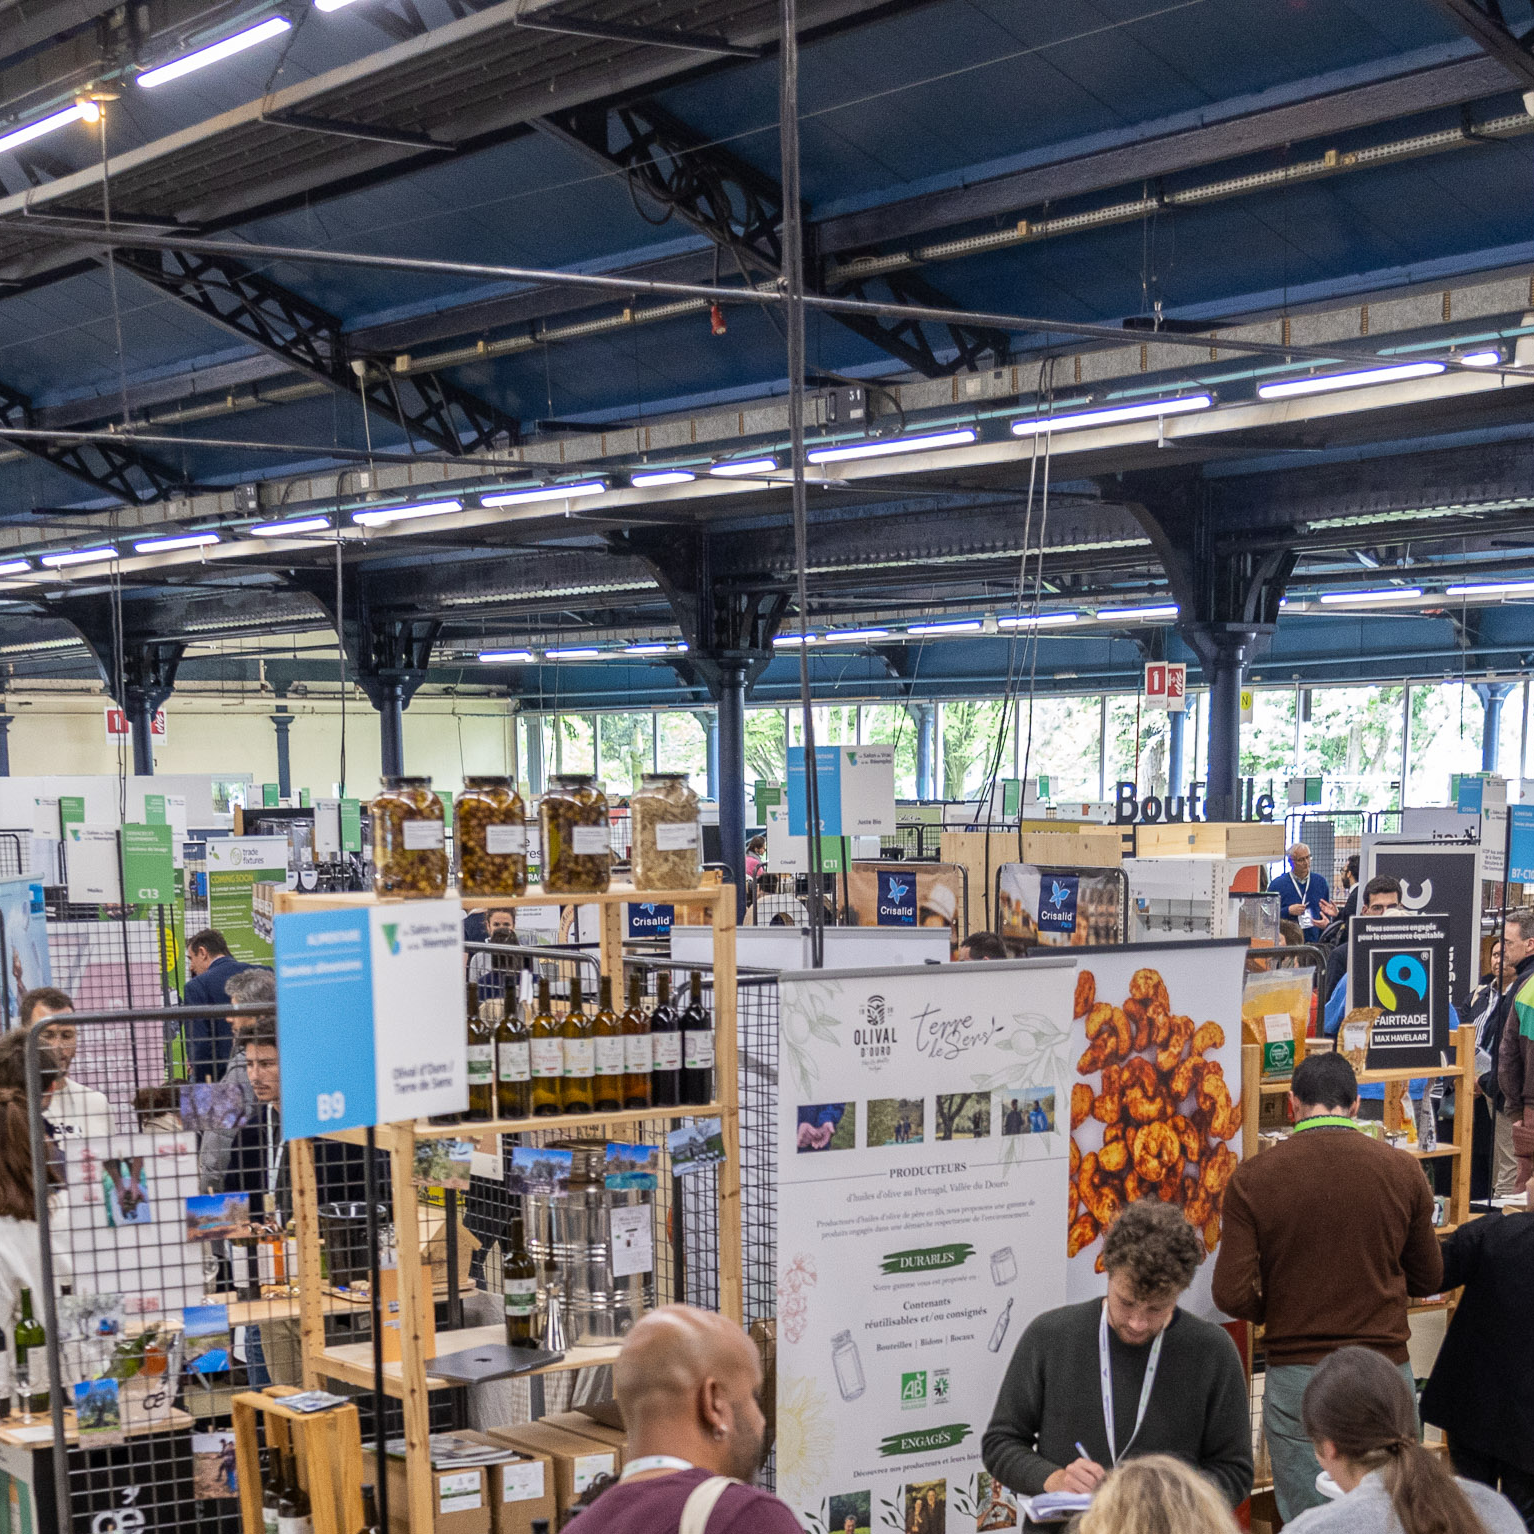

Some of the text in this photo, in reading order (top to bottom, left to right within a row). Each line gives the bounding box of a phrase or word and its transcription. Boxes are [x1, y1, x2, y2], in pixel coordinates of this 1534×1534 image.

[1116, 779, 1274, 823] Boutlle
[243, 848, 258, 856] trade
[242, 855, 265, 865] fixtures
[824, 859, 838, 869] C11
[138, 889, 159, 899] C13
[881, 906, 913, 916] Crisalid
[1041, 910, 1073, 921] Crisalid
[633, 916, 670, 926] Crisalid
[1366, 923, 1437, 932] Nous sommes engagés
[1357, 931, 1445, 942] pour le commerce équitable
[1374, 1014, 1428, 1027] FAIRTRADE
[854, 1027, 898, 1046] OLIVAL
[1374, 1033, 1428, 1042] MAX HAVELAAR
[860, 1046, 892, 1058] D'OURO
[318, 1091, 345, 1121] B9
[889, 1161, 967, 1180] PRODUCTEURS
[846, 1192, 876, 1203] d'huiles
[876, 1190, 902, 1201] d'olive
[914, 1185, 948, 1198] Portugal,
[949, 1182, 972, 1193] Vallée
[984, 1180, 1009, 1190] Douro
[816, 1216, 855, 1228] Producteurs
[900, 1251, 956, 1270] DURABLES
[903, 1297, 951, 1311] Contenants
[864, 1306, 988, 1331] réutilisables et/ou consignés
[876, 1333, 975, 1352] Bouteilles Bidons Bocaux
[902, 1378, 924, 1400] AB
[901, 1430, 952, 1450] ENGAGÉS
[853, 1467, 889, 1479] Découvrez
[902, 1459, 942, 1474] producteurs
[950, 1455, 966, 1465] leurs
